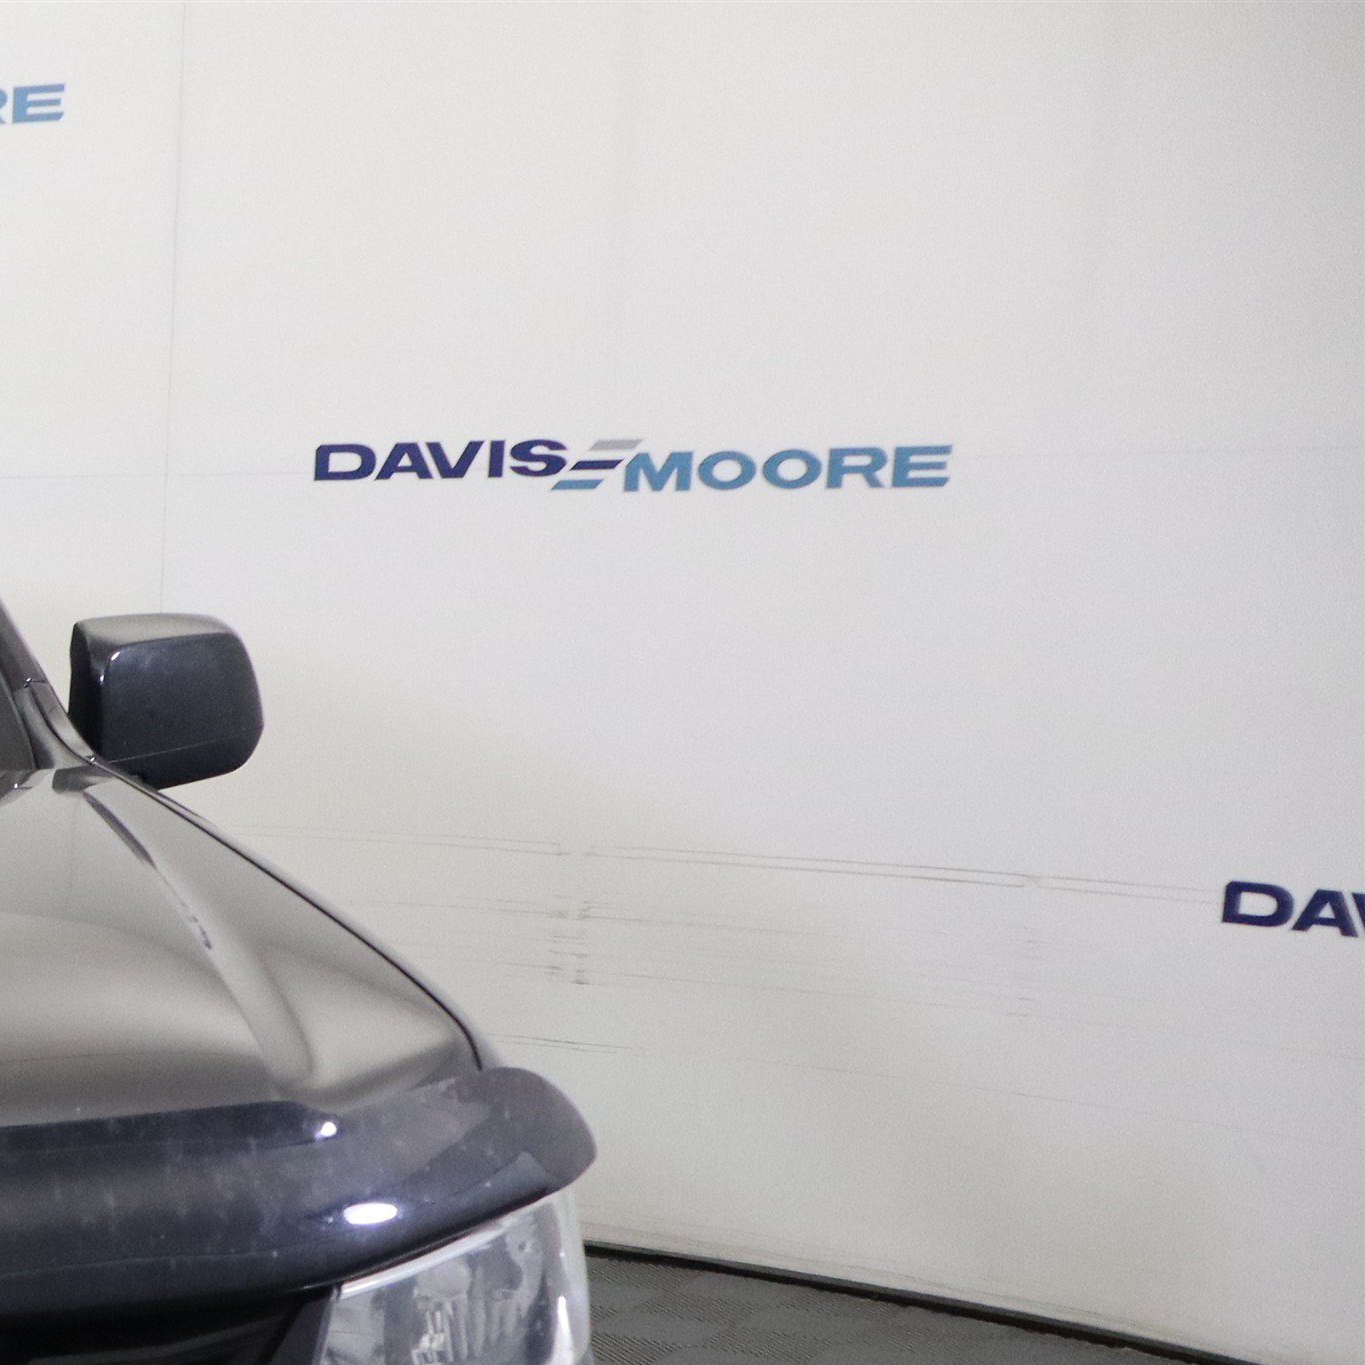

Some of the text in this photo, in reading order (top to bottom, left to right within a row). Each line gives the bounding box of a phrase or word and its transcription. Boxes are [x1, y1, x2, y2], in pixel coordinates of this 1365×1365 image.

[313, 439, 954, 493] DAVIS MOORE
[1220, 880, 1365, 938] DA
